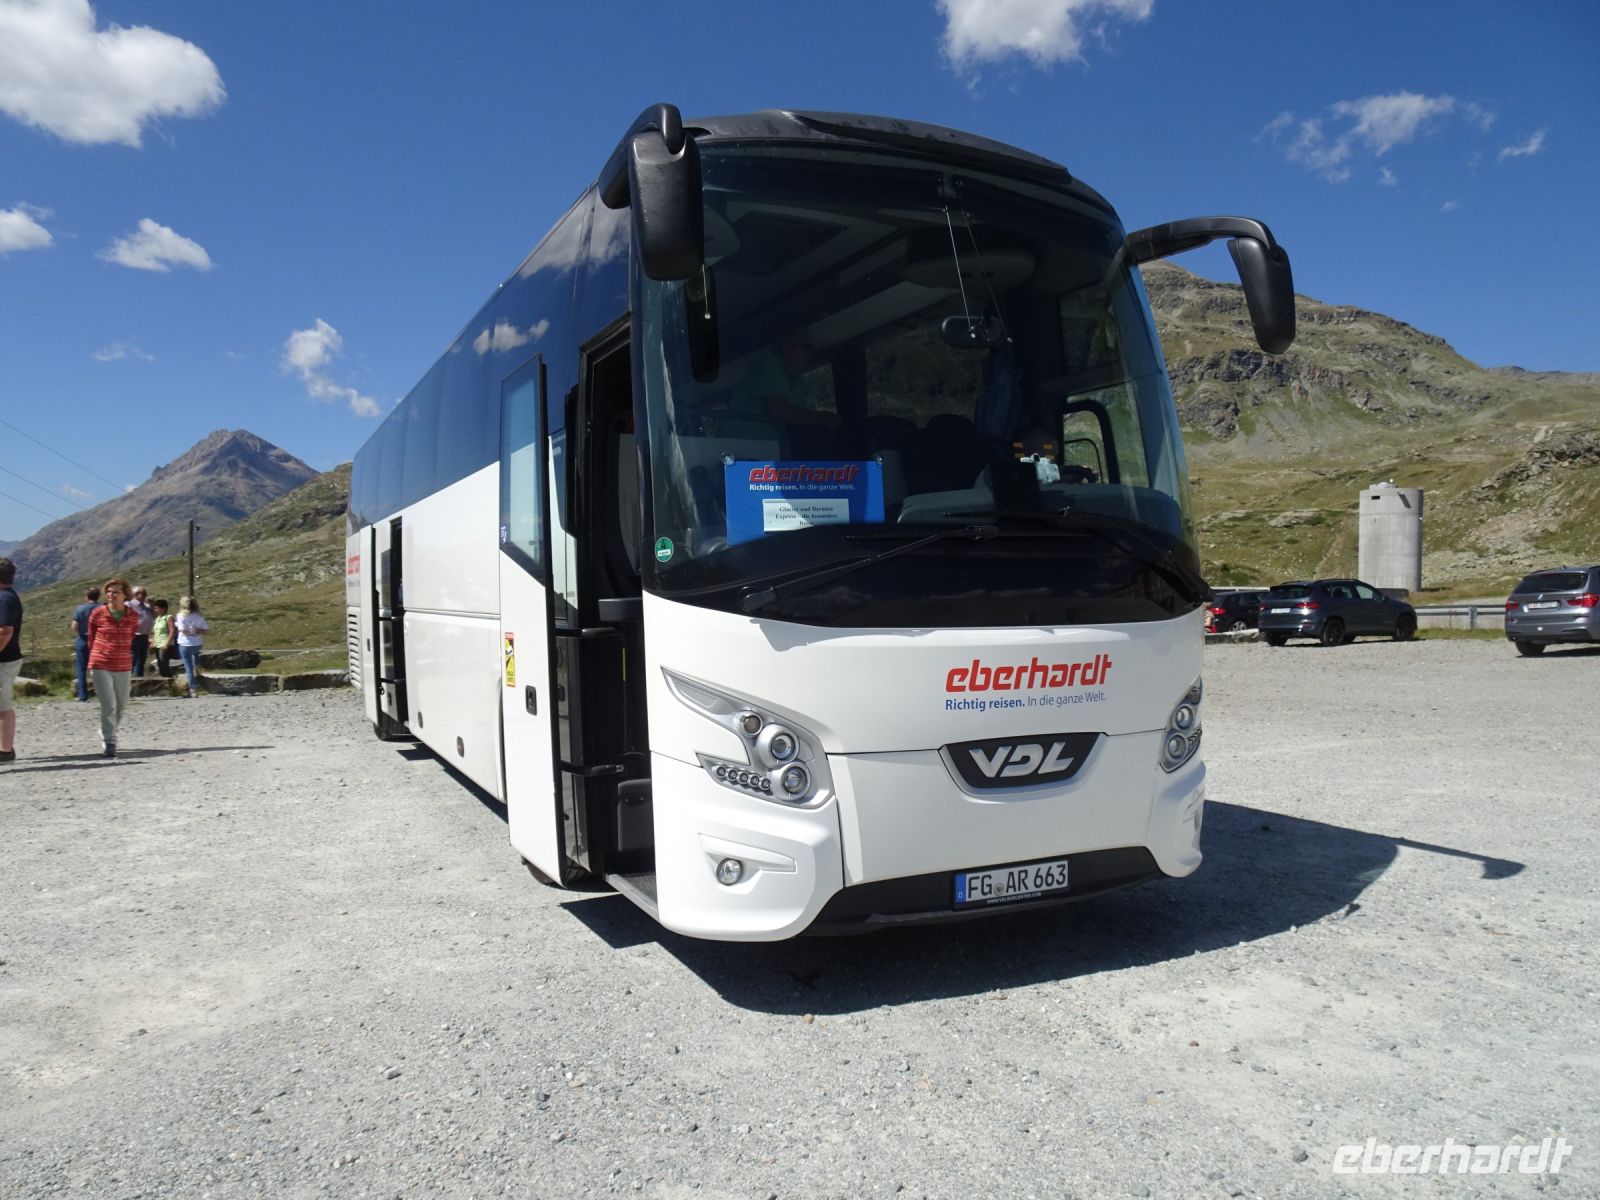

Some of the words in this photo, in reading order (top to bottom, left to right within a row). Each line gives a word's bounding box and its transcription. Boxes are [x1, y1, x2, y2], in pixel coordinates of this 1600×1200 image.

[749, 465, 859, 482] eberhardt
[749, 484, 774, 492] Richtig
[818, 485, 838, 493] ganze
[945, 654, 1112, 693] eberhardt
[945, 698, 986, 712] Richtig
[989, 697, 1025, 709] reisen.
[1028, 696, 1037, 706] In
[1039, 695, 1054, 706] die
[1056, 694, 1083, 708] ganze
[1085, 691, 1106, 702] Welt.
[968, 741, 1074, 778] VDL
[968, 874, 992, 899] FG
[1006, 870, 1028, 893] AR
[1034, 864, 1066, 889] 663
